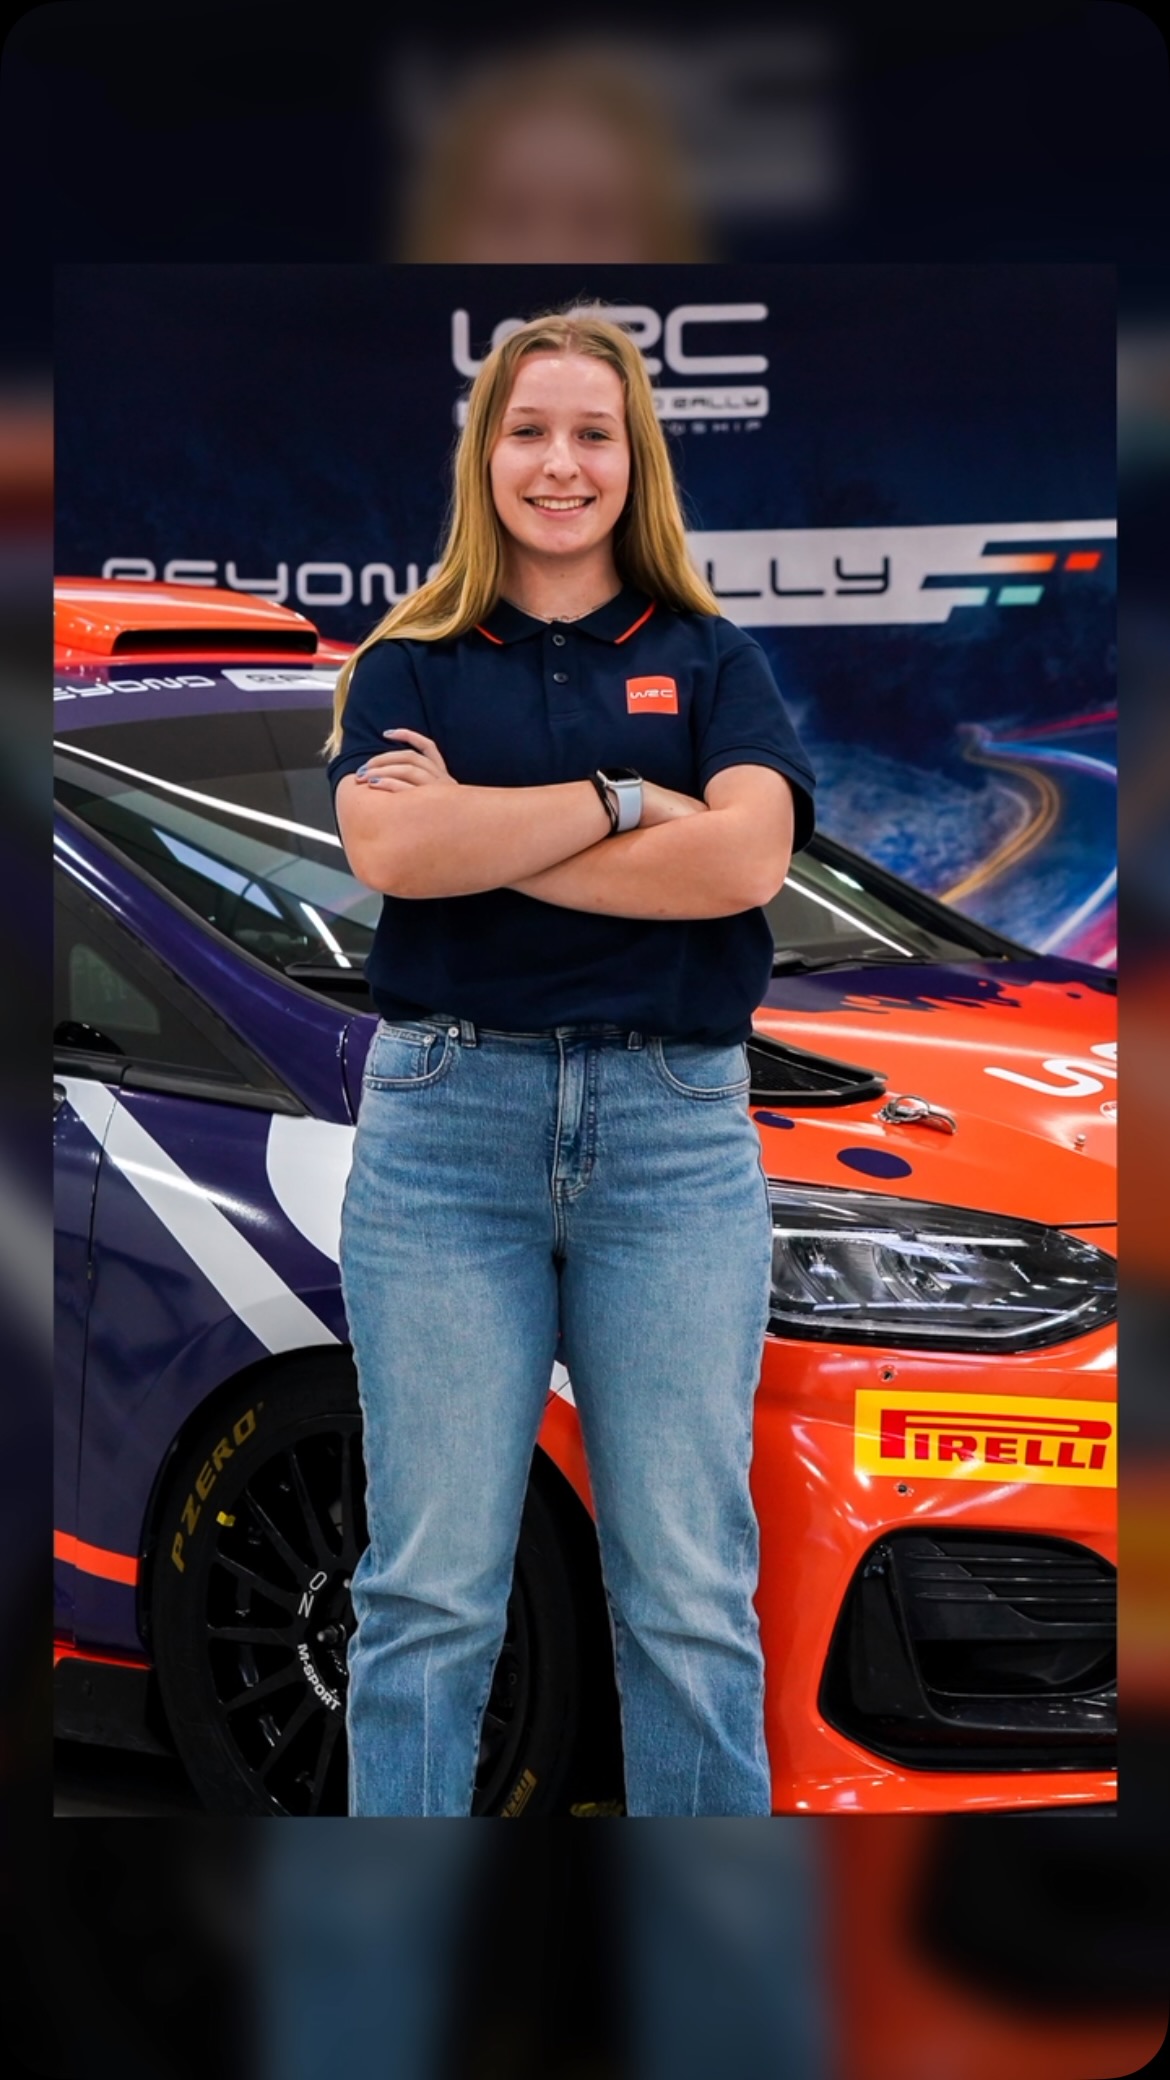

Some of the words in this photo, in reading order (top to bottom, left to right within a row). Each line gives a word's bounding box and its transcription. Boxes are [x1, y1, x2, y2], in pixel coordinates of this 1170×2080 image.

[102, 557, 446, 606] EYON
[707, 556, 890, 598] LLY
[629, 688, 674, 700] WRC
[880, 1409, 1112, 1470] PIRELLI
[297, 1643, 341, 1711] M-SPORT
